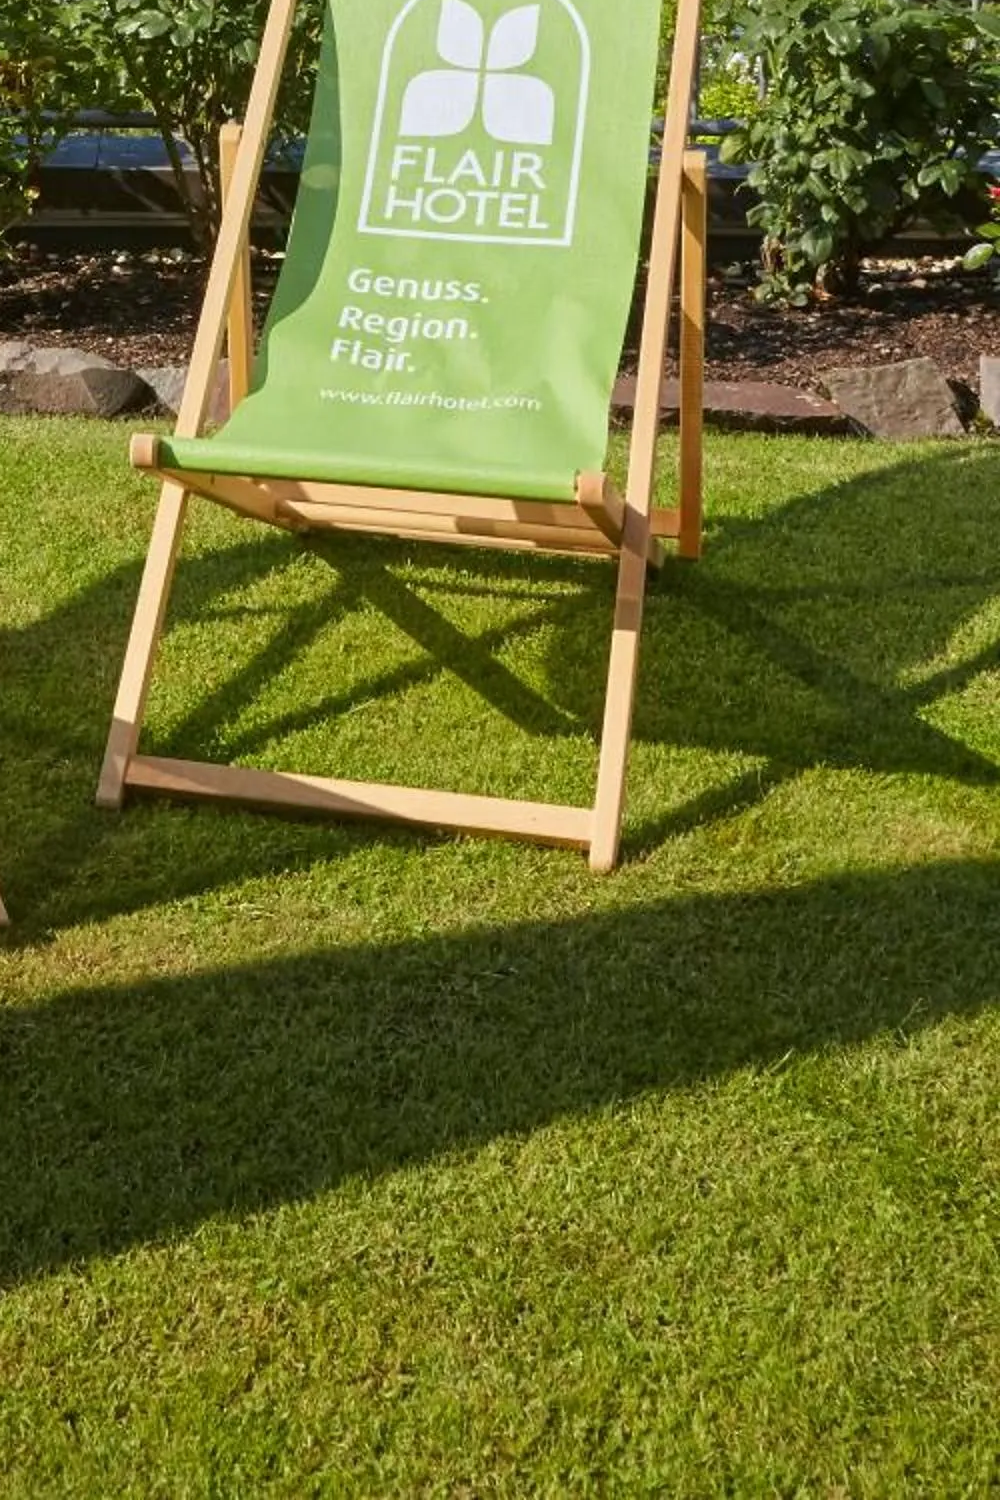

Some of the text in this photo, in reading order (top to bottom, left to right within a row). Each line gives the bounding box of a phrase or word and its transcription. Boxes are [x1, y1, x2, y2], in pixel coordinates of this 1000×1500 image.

[391, 146, 546, 188] FLAIR
[385, 187, 548, 229] HOTEL
[348, 268, 490, 303] Genuss.
[338, 306, 478, 343] Region.
[330, 340, 415, 373] Flair.
[319, 385, 542, 411] www.flairhotel.com
